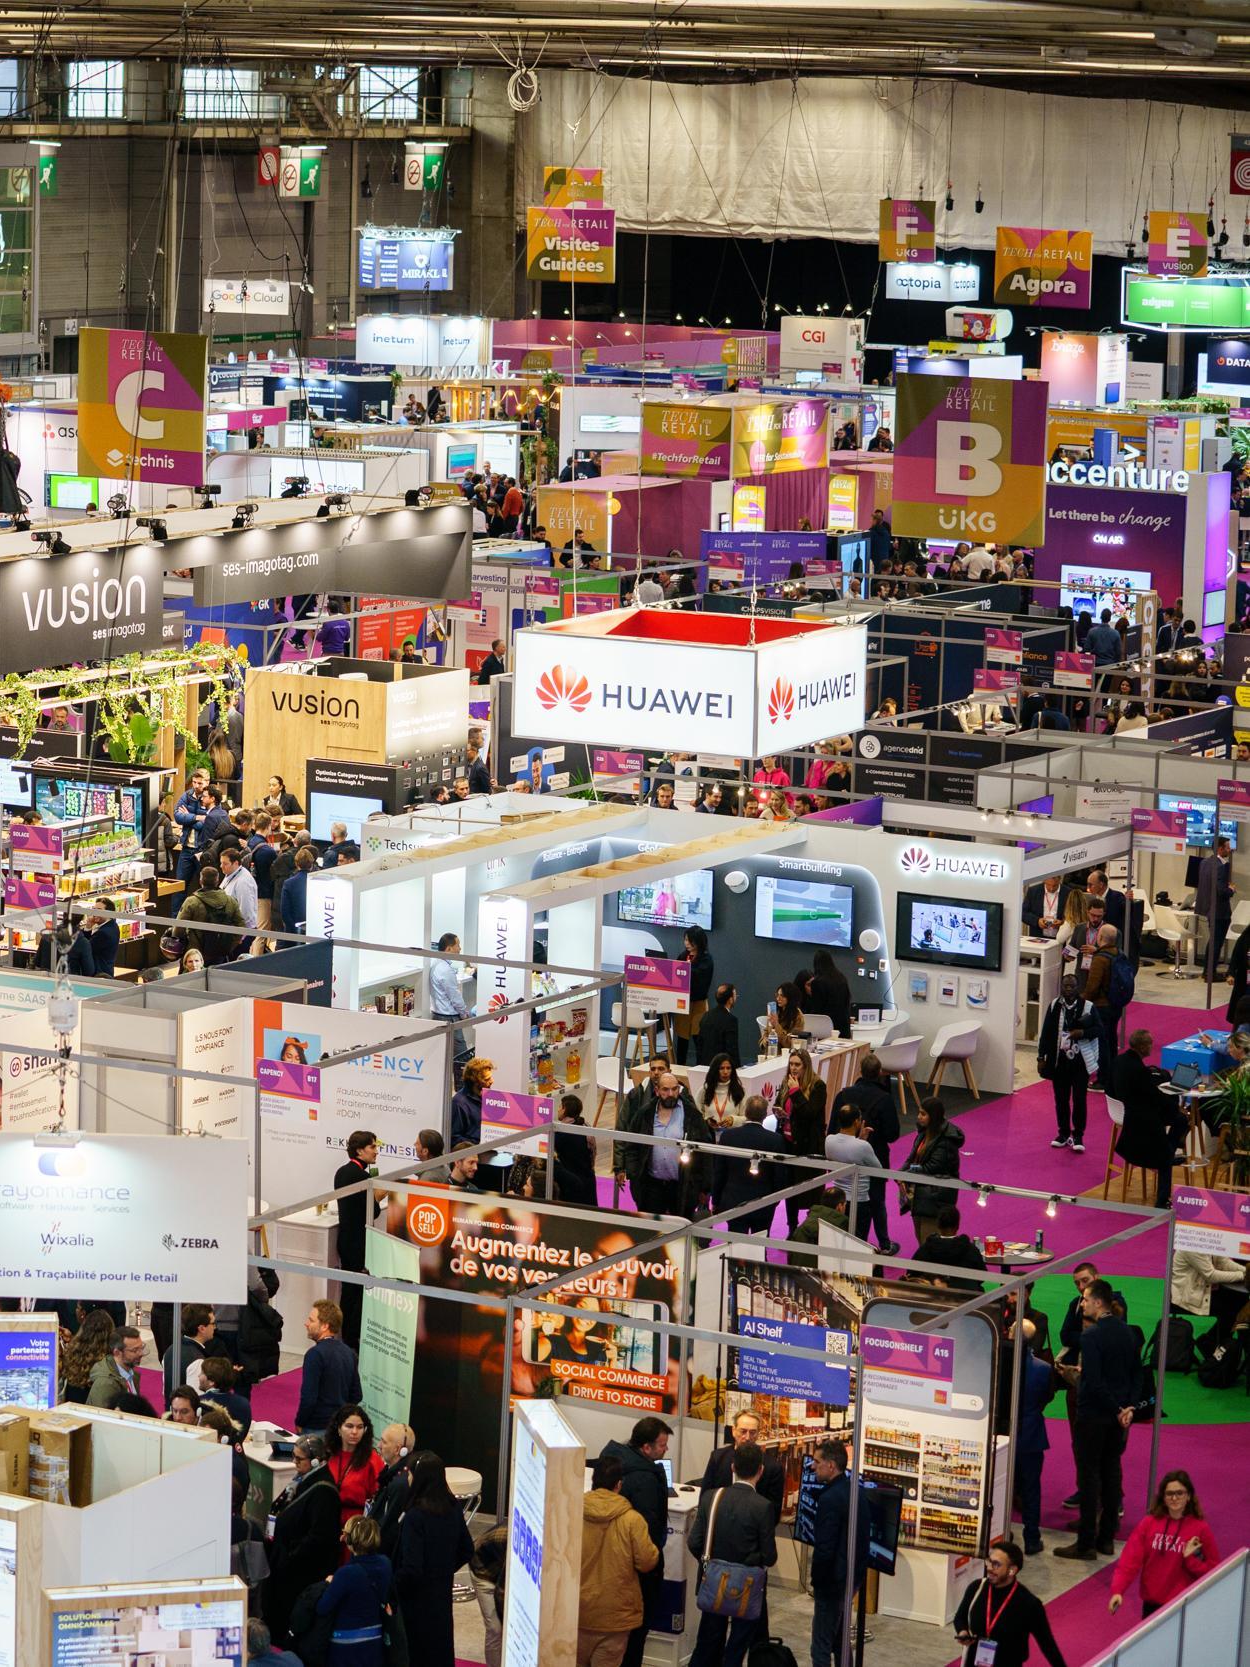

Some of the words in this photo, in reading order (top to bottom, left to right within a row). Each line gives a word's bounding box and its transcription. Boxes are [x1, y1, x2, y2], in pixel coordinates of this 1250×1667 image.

[571, 219, 609, 229] RETAIL
[896, 216, 918, 244] F
[543, 236, 600, 252] Visites
[1166, 228, 1191, 258] E
[1002, 247, 1034, 258] TECH
[1043, 249, 1084, 261] RETAIL
[539, 257, 605, 272] Guidées
[1162, 260, 1194, 271] vusion
[1009, 274, 1077, 297] Agora
[254, 291, 284, 304] Cloud
[373, 333, 415, 345] inetum
[802, 330, 826, 344] CGI
[121, 349, 163, 362] RETAIL
[115, 370, 166, 440] C
[946, 398, 997, 412] RETAIL
[782, 410, 817, 429] RETAIL
[661, 422, 711, 437] RETAIL
[126, 450, 175, 469] technis
[652, 452, 721, 466] #TechforRetail
[936, 420, 1003, 497] B
[549, 507, 584, 518] TECH
[1048, 508, 1067, 519] Let
[1068, 510, 1099, 522] there
[1100, 511, 1115, 523] be
[1118, 512, 1172, 531] change
[549, 518, 595, 531] RETAIL
[1093, 534, 1106, 544] ON
[1107, 534, 1124, 545] AIR
[223, 552, 319, 582] ses-imagotag.com
[22, 568, 146, 632] vusion
[257, 598, 269, 611] GK
[93, 628, 107, 640] ses
[108, 622, 146, 640] imagotag
[162, 624, 174, 637] GK
[798, 672, 856, 710] HUAWEI
[271, 690, 360, 719] vusion
[602, 683, 733, 719] HUAWEI
[315, 769, 336, 778] Optimize
[337, 772, 358, 781] Category
[359, 773, 389, 782] Management
[873, 780, 907, 789] INTERNATIONAL
[1134, 813, 1153, 822] VISIATIV
[1069, 849, 1088, 862] visiativ
[778, 859, 843, 877] Smartbuilding
[935, 857, 1005, 878] HUAWEI
[495, 916, 507, 988] HUAWEI
[627, 963, 645, 972] ATELIER
[18, 994, 46, 1005] SAAS
[194, 1034, 203, 1043] ILS
[203, 1031, 217, 1041] NOUS
[217, 1026, 233, 1038] FONT
[194, 1040, 224, 1054] CONFIANCE
[259, 1066, 284, 1077] CAPENCY
[307, 1075, 317, 1083] B17
[336, 1087, 402, 1102] #autocomplétion
[336, 1097, 417, 1115] #traitementdonnées
[485, 1098, 511, 1109] POPSELL
[538, 1106, 550, 1115] B18
[1177, 1195, 1208, 1207] AJUSTEO
[418, 1210, 437, 1223] POP
[417, 1223, 436, 1235] SELL
[452, 1216, 473, 1225] HUMAN
[474, 1219, 500, 1229] POWERED
[501, 1223, 534, 1233] COMMERCE
[40, 1232, 94, 1248] Wixalia
[180, 1237, 219, 1249] ZEBRA
[450, 1230, 571, 1266] Augmentez
[573, 1246, 593, 1267] le
[24, 1269, 32, 1278] &
[35, 1267, 97, 1282] Traçabilité
[100, 1273, 128, 1283] pour
[130, 1271, 141, 1281] le
[144, 1272, 178, 1283] Retail
[450, 1253, 477, 1275] de
[480, 1261, 517, 1283] vos
[744, 1321, 756, 1333] AI
[757, 1324, 783, 1339] Shelf
[10, 1347, 50, 1355] partenaire
[30, 1339, 50, 1348] Votre
[864, 1337, 924, 1353] FOCUSONSHELF
[6, 1352, 50, 1361] connectivité
[554, 1361, 596, 1381] SOCIAL
[598, 1368, 665, 1390] COMMERCE
[572, 1385, 604, 1401] DRIVE
[605, 1389, 620, 1404] TO
[622, 1391, 657, 1408] STORE
[58, 1612, 102, 1623] SOLUTIONS
[58, 1620, 114, 1630] OMNICANALES
